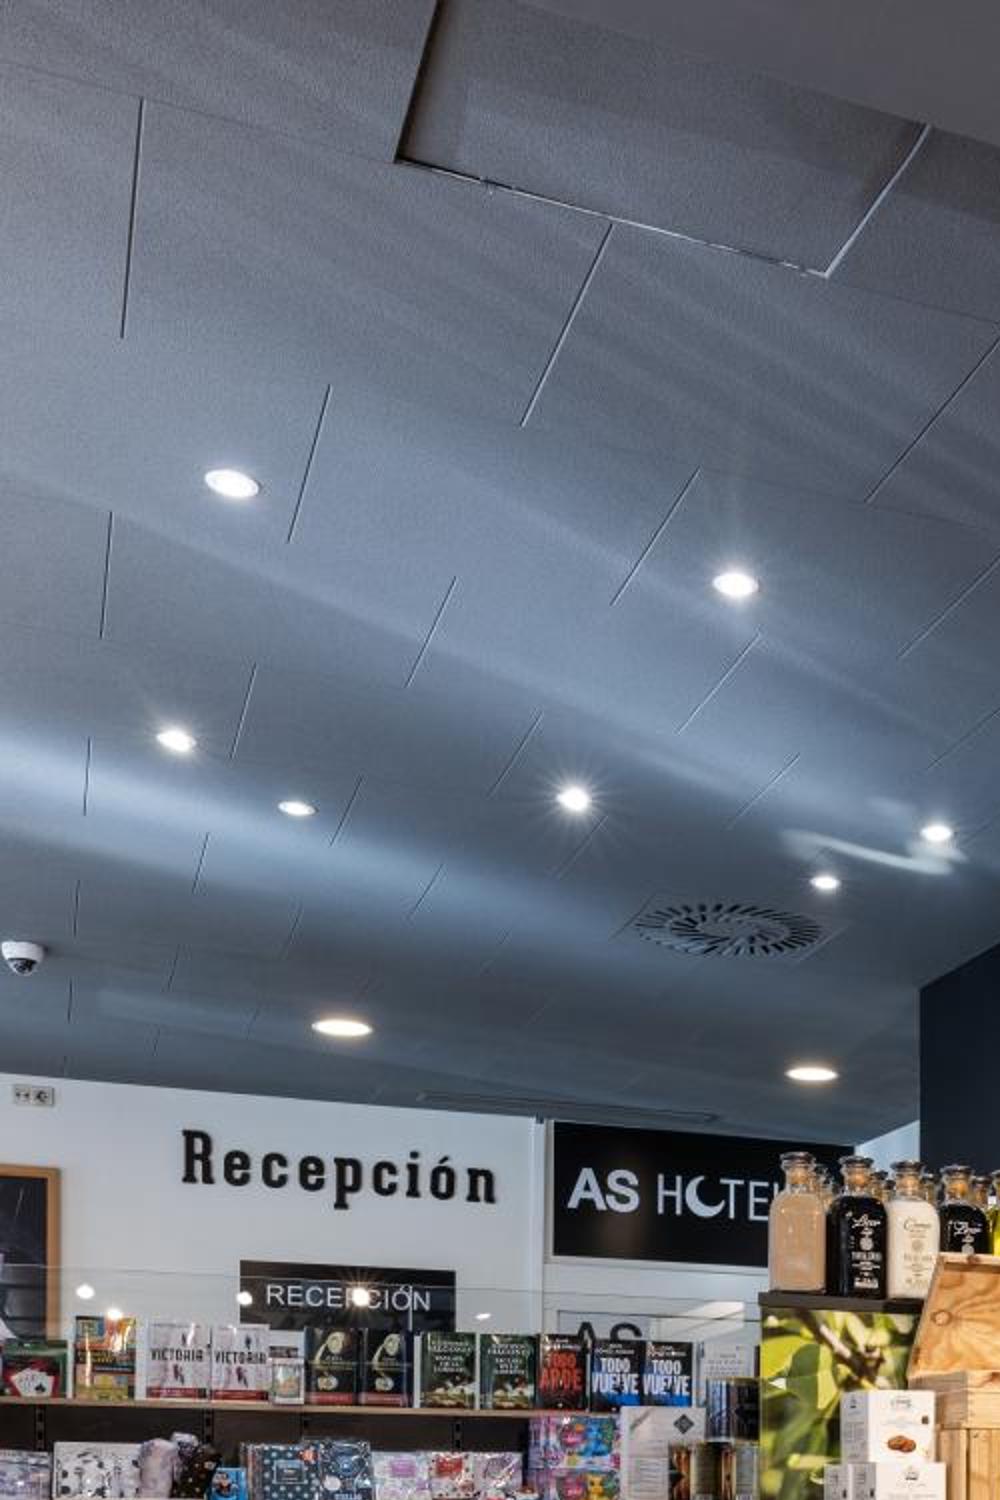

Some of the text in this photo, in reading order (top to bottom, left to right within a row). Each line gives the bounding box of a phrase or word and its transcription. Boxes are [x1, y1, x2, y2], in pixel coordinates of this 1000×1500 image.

[181, 1129, 497, 1210] Recepción
[566, 1167, 640, 1213] AS
[266, 1284, 432, 1312] RECECIÓN
[151, 1349, 204, 1363] VICTORIA
[215, 1351, 267, 1365] VICTORIA
[600, 1357, 631, 1373] TODO
[652, 1358, 682, 1375] TODO
[540, 1369, 584, 1393] ARDE
[591, 1372, 640, 1396] VUELVE
[642, 1373, 692, 1396] VUELVE
